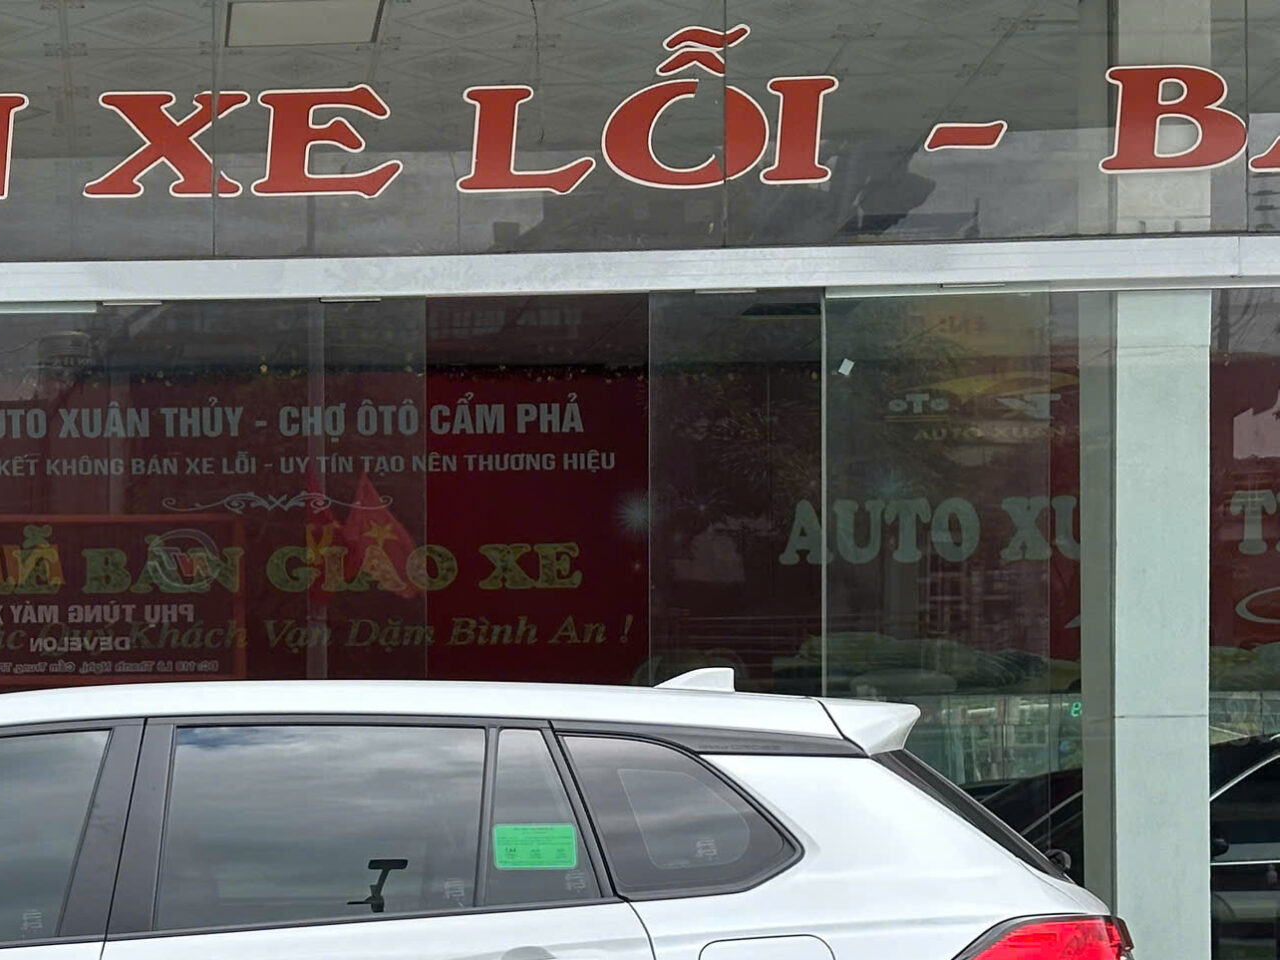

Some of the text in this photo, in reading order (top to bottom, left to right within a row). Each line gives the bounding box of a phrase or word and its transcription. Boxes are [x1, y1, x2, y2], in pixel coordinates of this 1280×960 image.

[82, 83, 403, 199] XE
[456, 23, 839, 194] LỖI
[1098, 64, 1280, 174] B
[58, 401, 150, 438] XUÂN
[160, 396, 243, 438] THỦY
[278, 403, 348, 443] CHỢ
[356, 399, 419, 436] ÔTÔ
[430, 392, 505, 435] CẨM
[516, 392, 584, 434] PHẢ
[46, 455, 125, 476] KHÔNG
[131, 454, 178, 475] BÁN
[186, 457, 215, 474] XE
[222, 451, 256, 474] LỖI
[280, 456, 310, 474] UY
[315, 453, 355, 474] TÍN
[361, 456, 405, 476] TẠO
[412, 451, 457, 472] NÊN
[464, 452, 556, 472] THƯƠNG
[563, 450, 616, 473] HIỆU
[779, 496, 980, 565] AUTO
[265, 545, 458, 593] GIAO
[478, 542, 583, 590] XE
[129, 616, 249, 650] Khách
[264, 618, 334, 653] Vạn
[344, 618, 436, 653] Dặm
[447, 616, 538, 647] Bình
[547, 615, 608, 645] An
